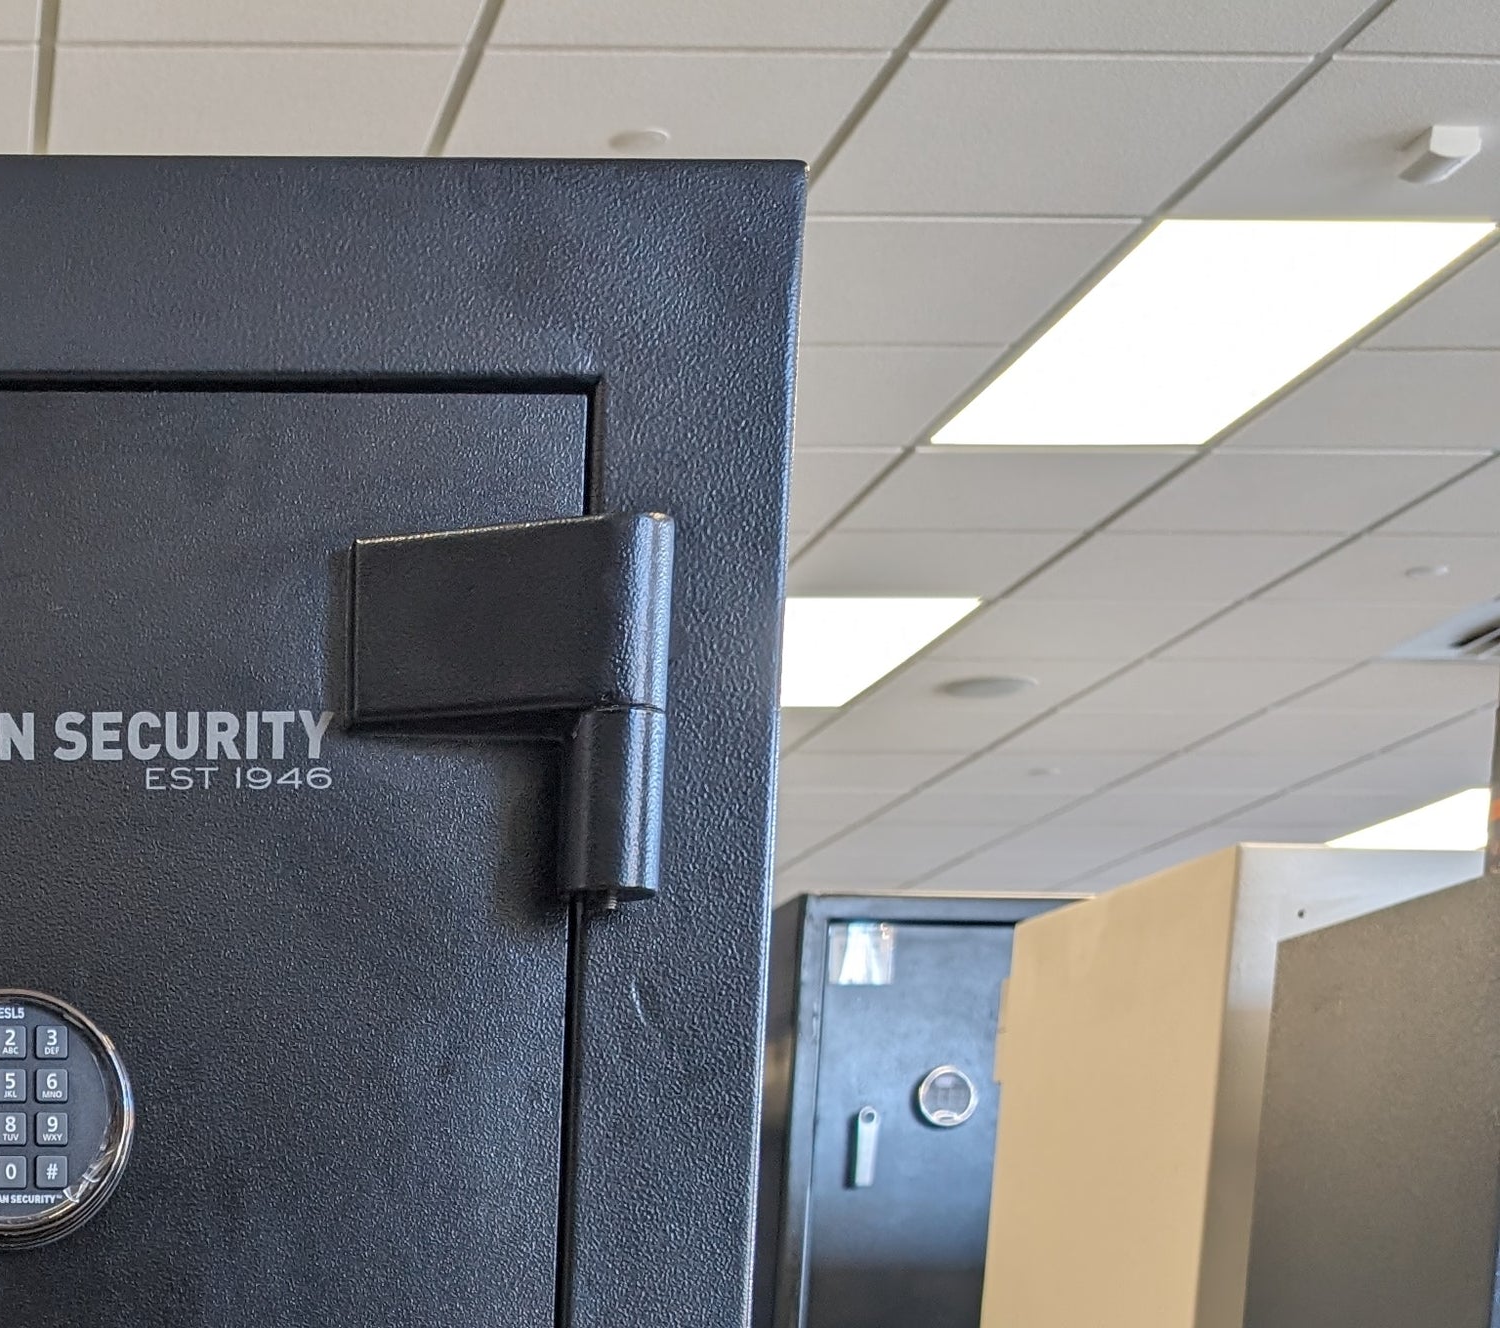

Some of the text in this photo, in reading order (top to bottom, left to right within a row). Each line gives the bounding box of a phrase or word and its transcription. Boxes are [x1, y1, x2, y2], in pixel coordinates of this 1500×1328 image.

[53, 710, 333, 761] SECURITY
[145, 766, 333, 790] EST 1946
[4, 1029, 16, 1046] 2
[46, 1029, 58, 1046] 3
[2, 1046, 19, 1055] ABC
[44, 1046, 60, 1055] DEF
[4, 1072, 16, 1089] 5
[46, 1073, 58, 1090] 6
[3, 1090, 18, 1098] JKL
[41, 1090, 63, 1098] MNO
[4, 1115, 17, 1133] 8
[46, 1116, 58, 1133] 9
[2, 1133, 19, 1142] TUV
[42, 1133, 63, 1142] WXY
[5, 1163, 17, 1180] 0
